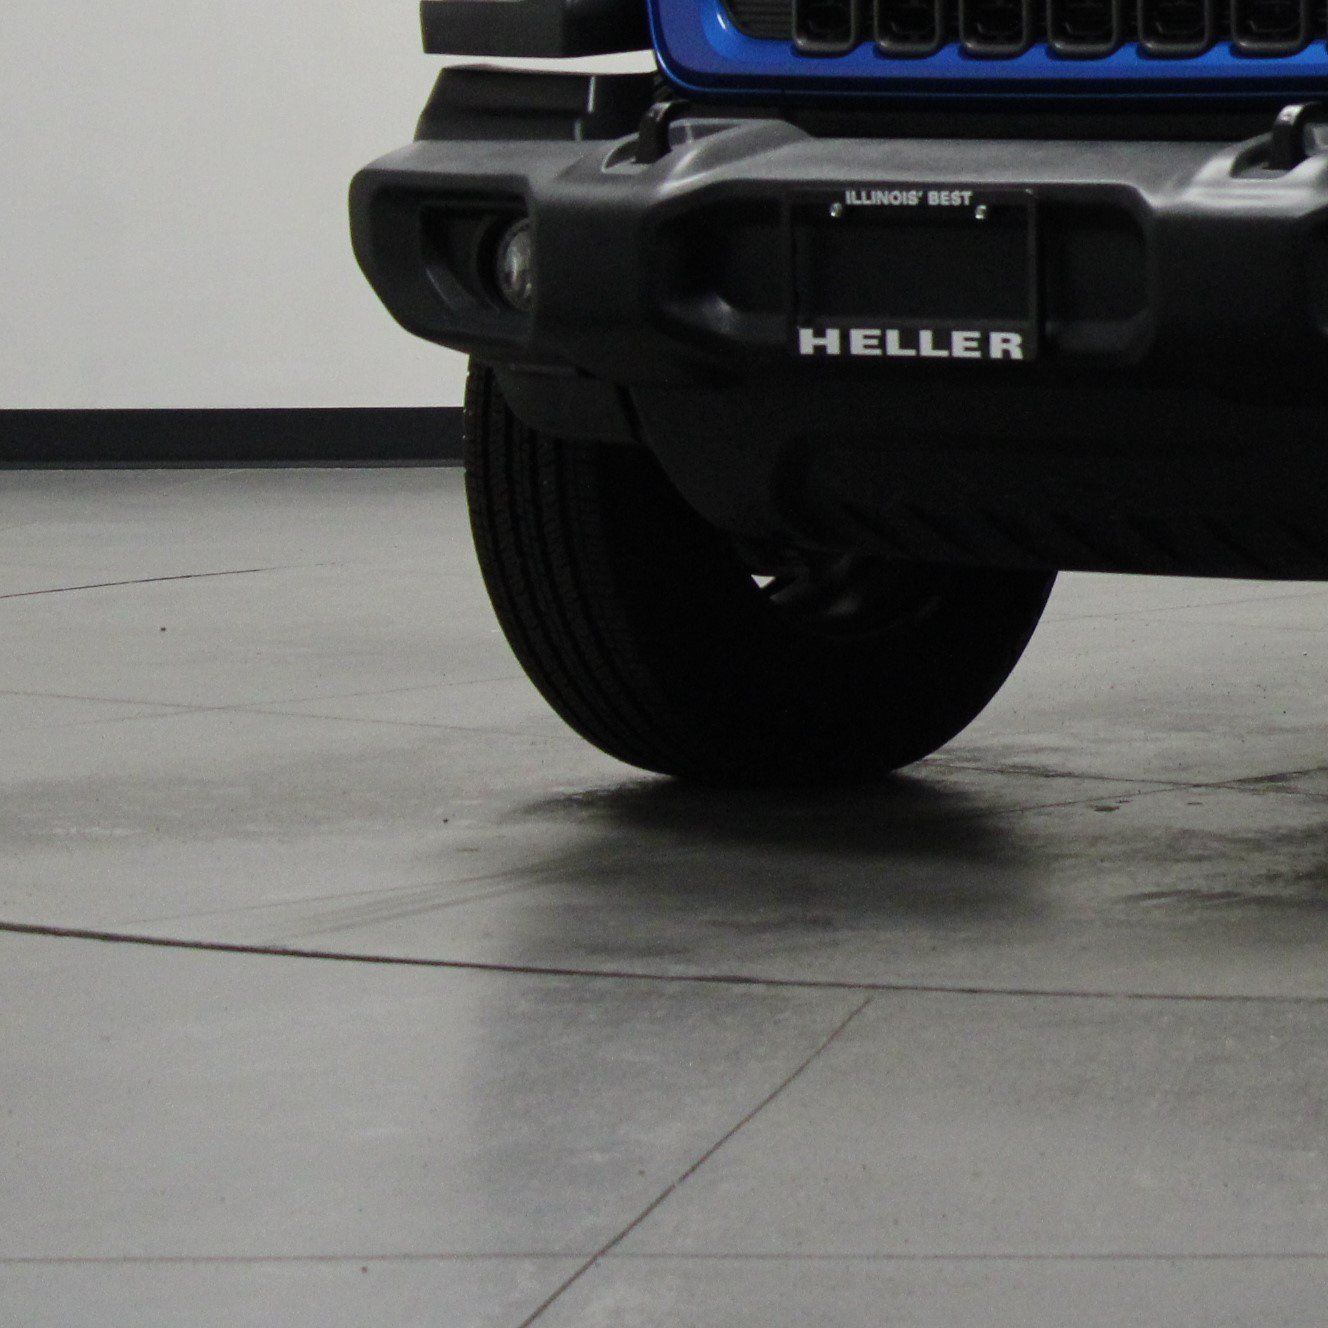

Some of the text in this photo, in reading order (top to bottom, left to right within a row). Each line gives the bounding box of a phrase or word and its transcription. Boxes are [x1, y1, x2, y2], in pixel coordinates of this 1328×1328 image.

[845, 188, 975, 207] ILLINOIS' BEST
[798, 327, 1024, 361] HELLER
